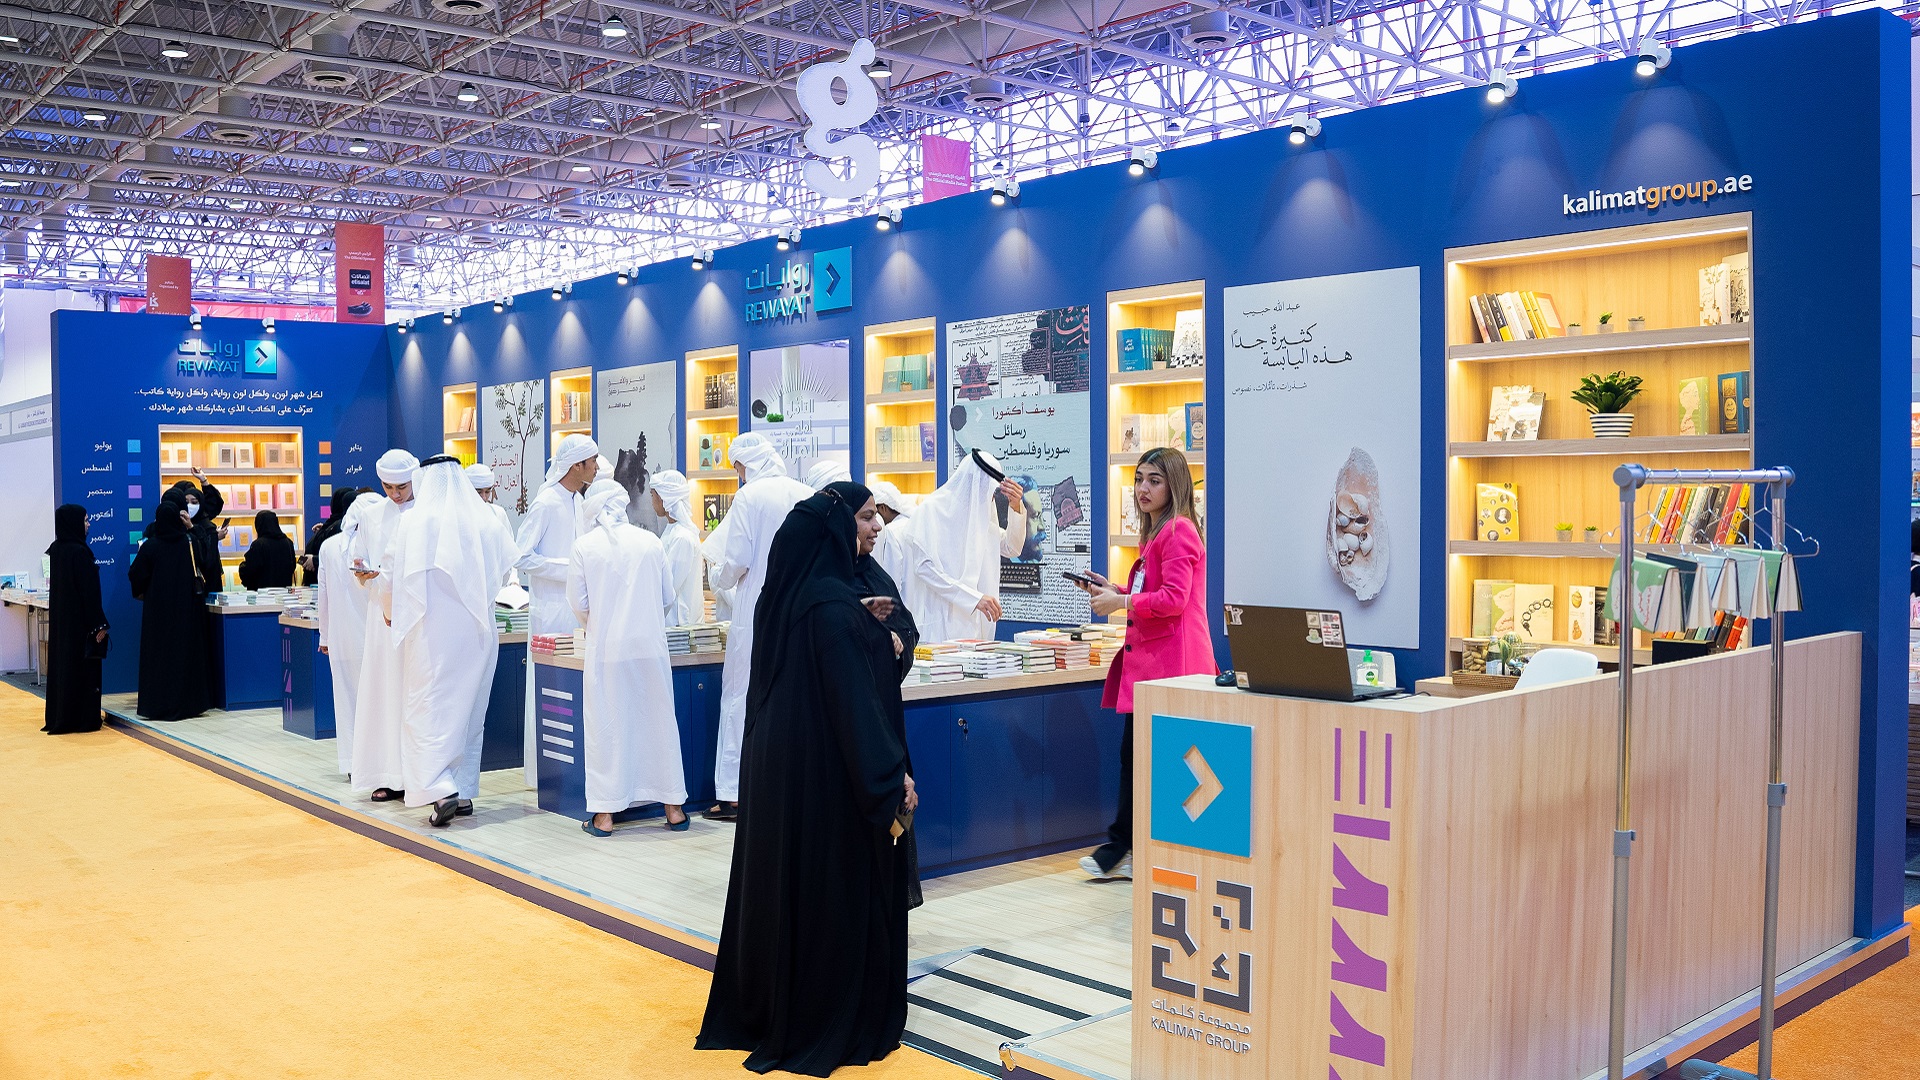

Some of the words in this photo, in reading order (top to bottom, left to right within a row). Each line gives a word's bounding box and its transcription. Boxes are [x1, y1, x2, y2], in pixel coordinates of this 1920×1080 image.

[1563, 174, 1753, 215] kalimatgroup.ae
[746, 260, 810, 290] روايات
[746, 293, 810, 322] REWAYAT
[1274, 300, 1284, 312] الله
[1286, 303, 1300, 312] عبد
[1242, 307, 1270, 318] حبيب
[178, 338, 240, 358] روايات
[1262, 347, 1308, 370] اليابسة
[1312, 346, 1352, 364] هذه
[178, 360, 240, 372] REWAYAT
[166, 388, 184, 399] رواية
[186, 388, 208, 399] ولكل
[232, 389, 246, 400] لون
[248, 389, 270, 400] ولكل
[290, 390, 305, 400] شهر
[306, 390, 323, 400] لكل
[149, 403, 176, 413] ميلادك
[177, 404, 194, 414] شهر
[195, 404, 226, 415] يشاركك
[227, 404, 245, 415] الذي
[247, 405, 276, 414] الكاتب
[278, 405, 292, 416] على
[992, 402, 1024, 420] أكشورا
[1026, 404, 1056, 417] يوسف
[993, 423, 1026, 440] رسائل
[94, 441, 112, 452] يوليو
[349, 444, 362, 453] يناير
[993, 442, 1042, 461] وفلسطين
[1044, 442, 1070, 461] سوريا
[81, 462, 112, 474] أغسطس
[346, 464, 362, 475] فبراير
[87, 488, 113, 498] سبتمبر
[89, 508, 114, 521] أكتوبر
[90, 533, 114, 544] نوفمبر
[94, 558, 115, 566] ديسم
[1152, 998, 1195, 1019] كلمات
[1198, 1010, 1252, 1036] مجموعة
[1152, 1016, 1203, 1042] KALIMAT
[1206, 1032, 1251, 1054] GROUP
